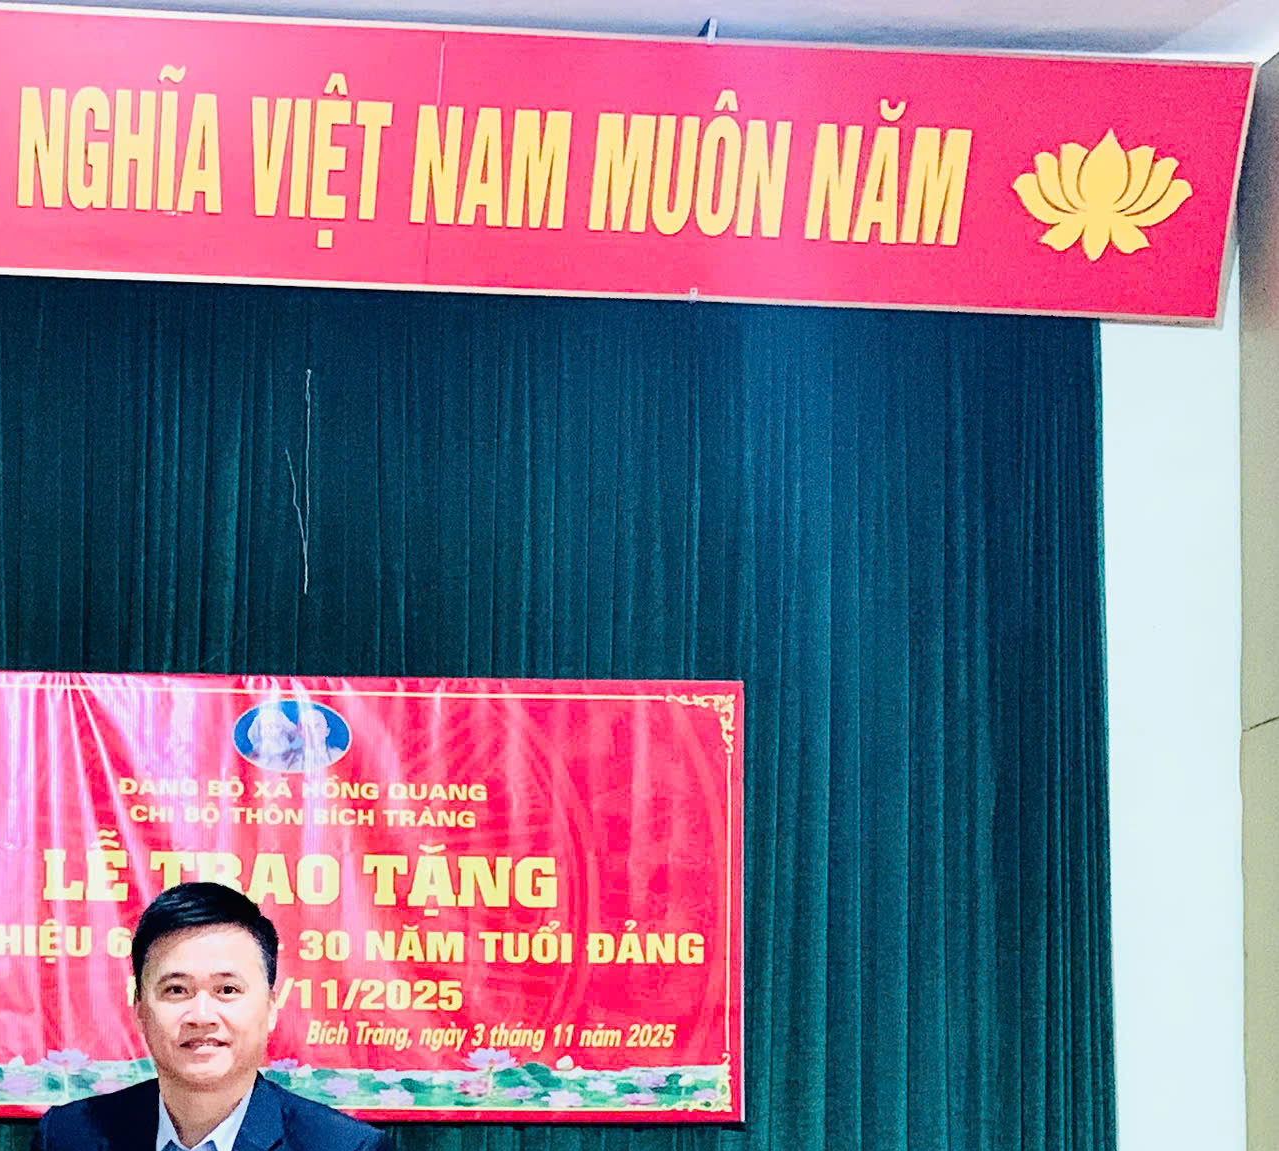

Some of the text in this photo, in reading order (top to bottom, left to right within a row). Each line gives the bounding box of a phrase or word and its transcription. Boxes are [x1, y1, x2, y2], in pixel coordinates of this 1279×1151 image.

[16, 64, 223, 215] NGHĨA
[251, 72, 394, 250] VIỆT
[409, 104, 573, 231] NAM
[587, 90, 795, 241] MUÔN
[804, 97, 975, 248] NĂM
[119, 772, 488, 803] ĐẢNG BỘ XÃ HỒNG QUANG
[130, 802, 477, 828] CHI BỘ THÔN BÍCH TRÀNG
[42, 829, 558, 917] LỄ TRAO TẶNG
[107, 926, 133, 958] 6
[299, 930, 350, 961] 30
[365, 924, 465, 963] NĂM
[478, 920, 573, 964] TUỔI
[586, 919, 705, 965] ĐẢNG
[277, 977, 464, 1011] /11/2025
[306, 1020, 676, 1053] Bích Tràng, ngày 3 tháng 11 năm 2025
